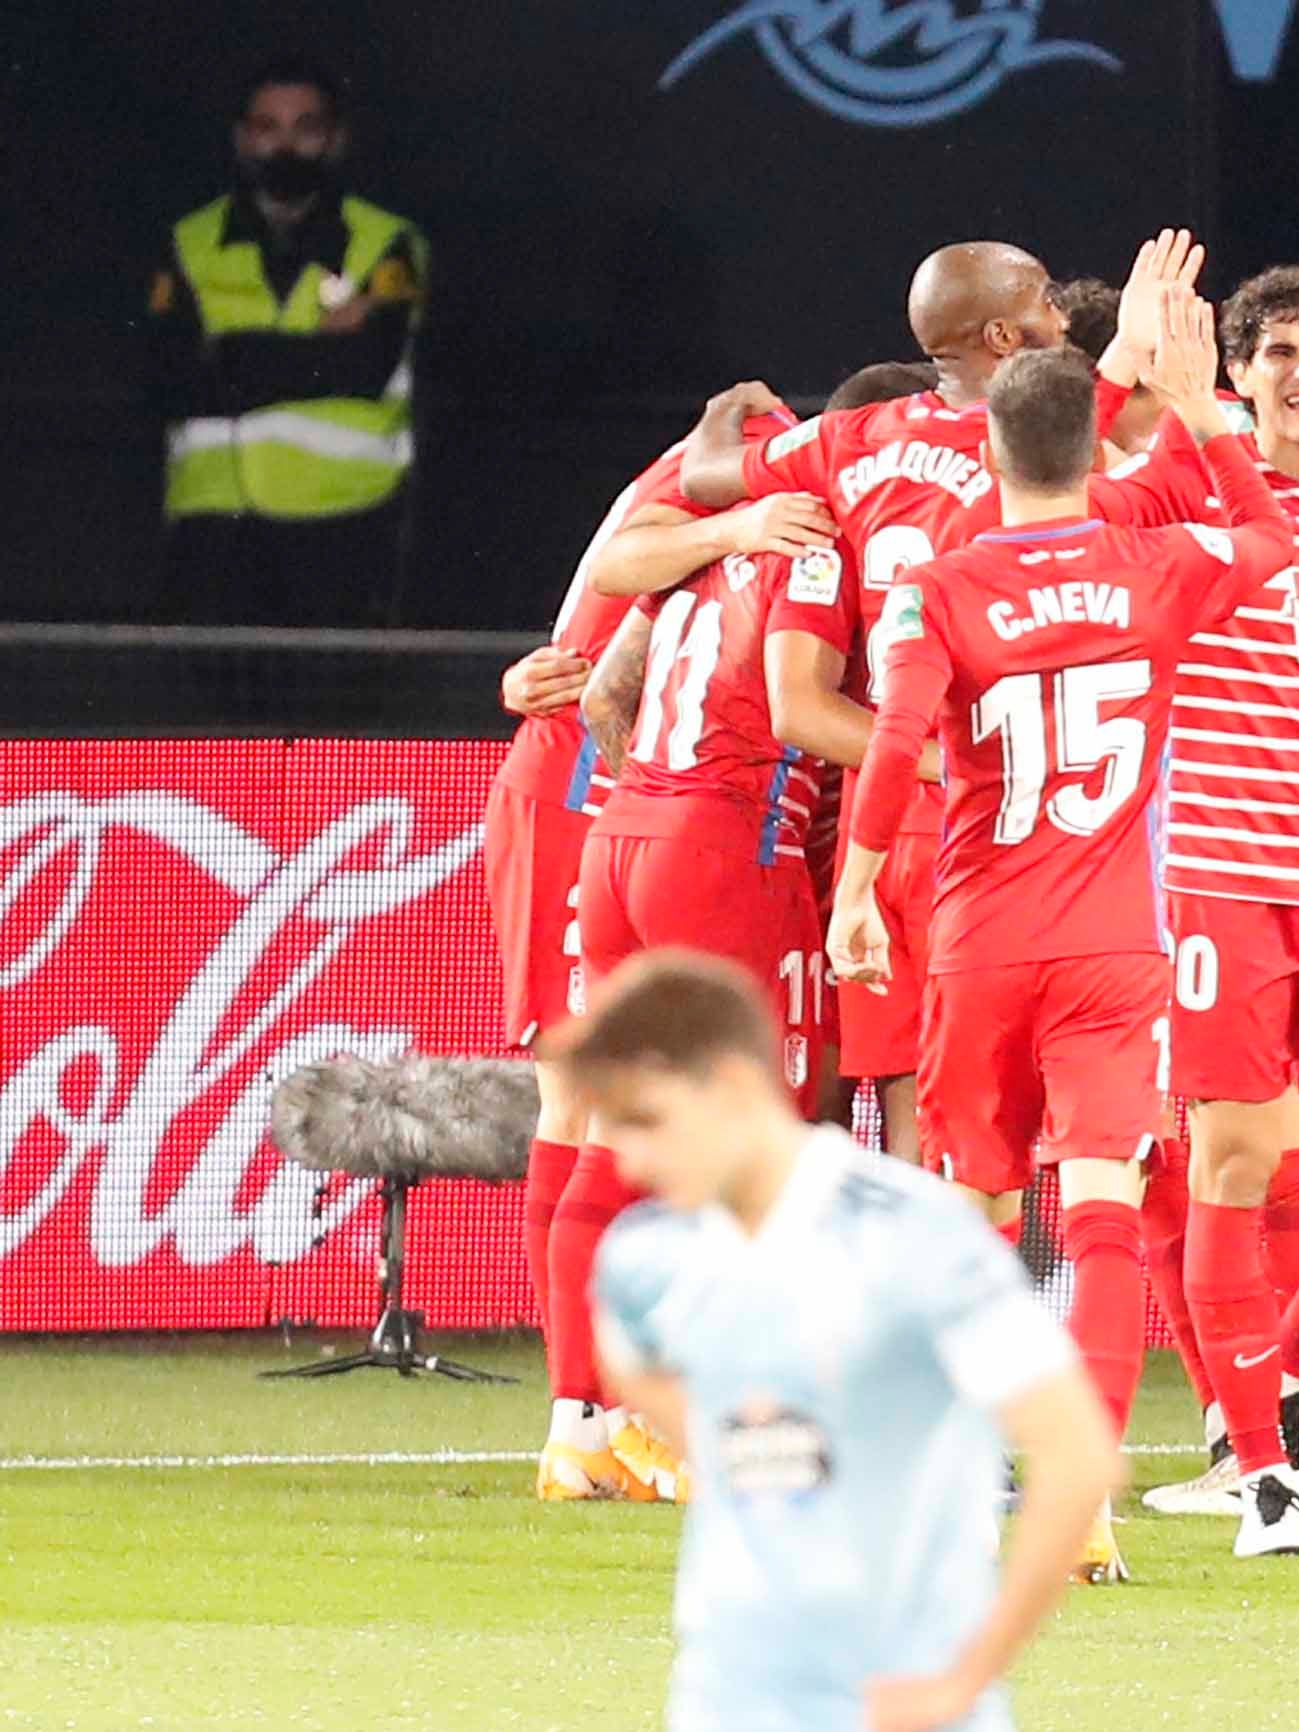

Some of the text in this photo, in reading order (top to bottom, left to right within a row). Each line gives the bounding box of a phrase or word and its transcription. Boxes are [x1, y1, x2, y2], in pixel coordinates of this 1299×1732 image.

[986, 581, 1131, 641] C.NEVA
[631, 590, 724, 771] 11
[972, 660, 1152, 845] 15
[779, 950, 823, 1025] 11
